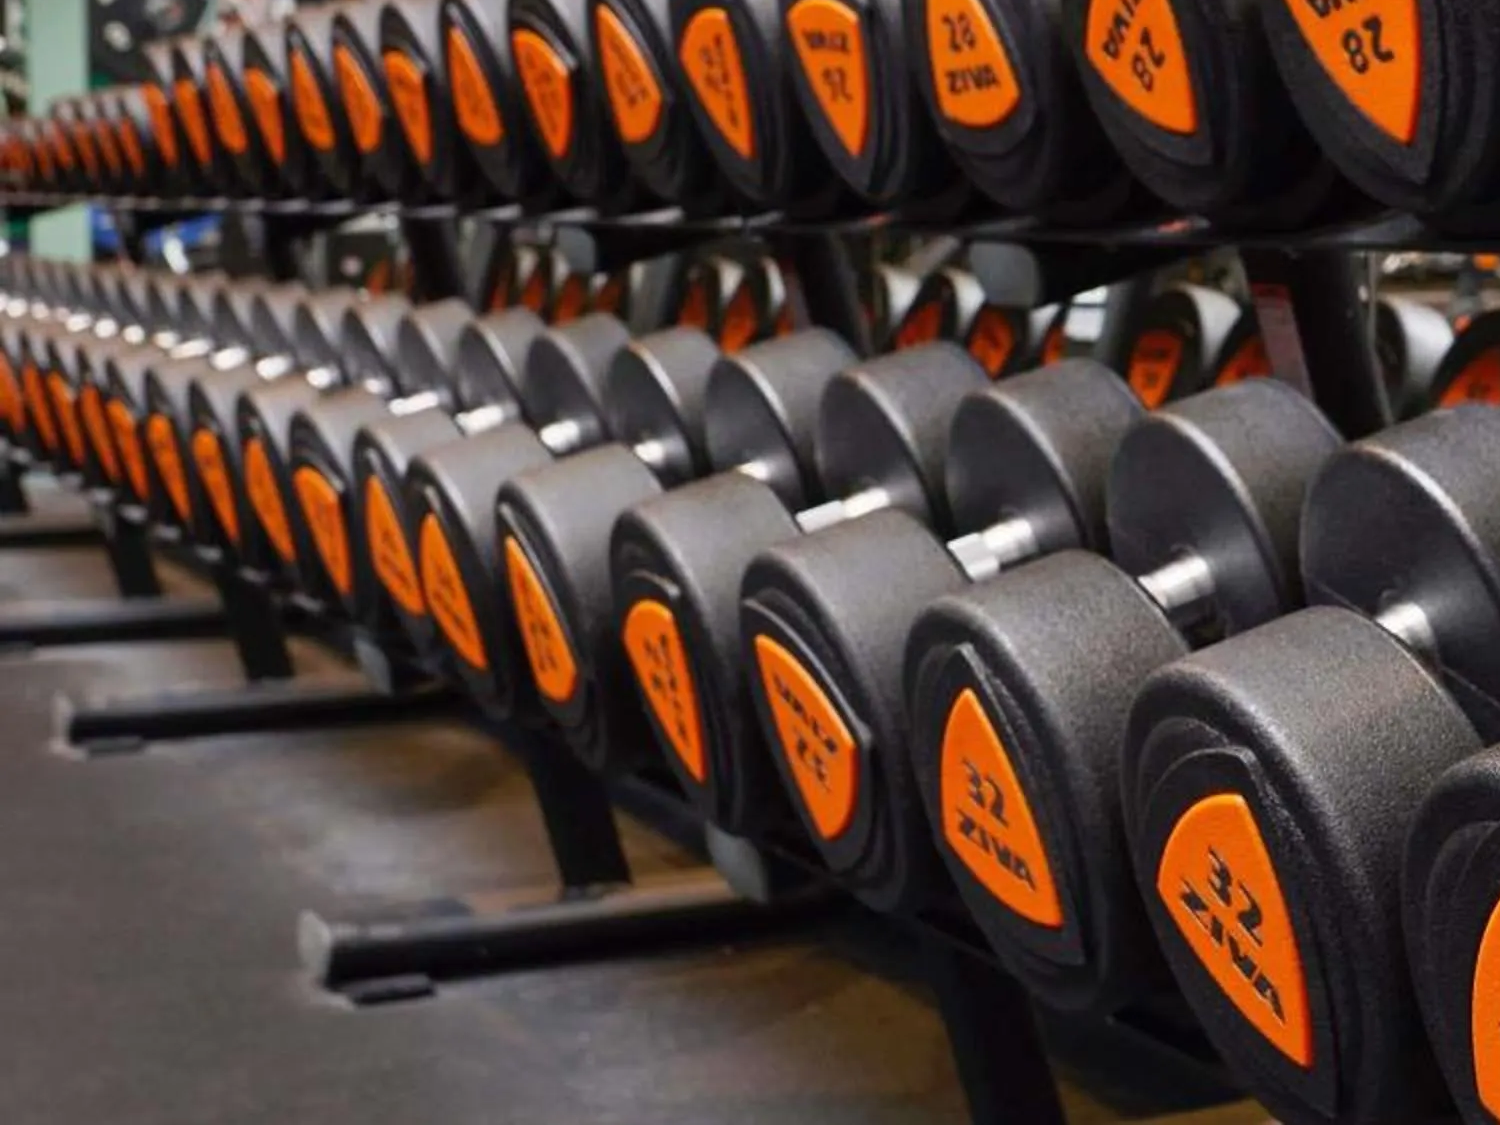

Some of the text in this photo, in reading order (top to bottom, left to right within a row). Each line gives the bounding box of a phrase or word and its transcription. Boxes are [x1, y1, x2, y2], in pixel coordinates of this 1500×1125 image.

[945, 64, 1001, 95] ZIVA
[1131, 27, 1166, 92] 28
[1342, 15, 1395, 75] 28
[963, 757, 1009, 829] 32
[956, 807, 1037, 893] ZIVA
[1208, 845, 1263, 948] 32
[1180, 877, 1285, 1025] ZIVA
